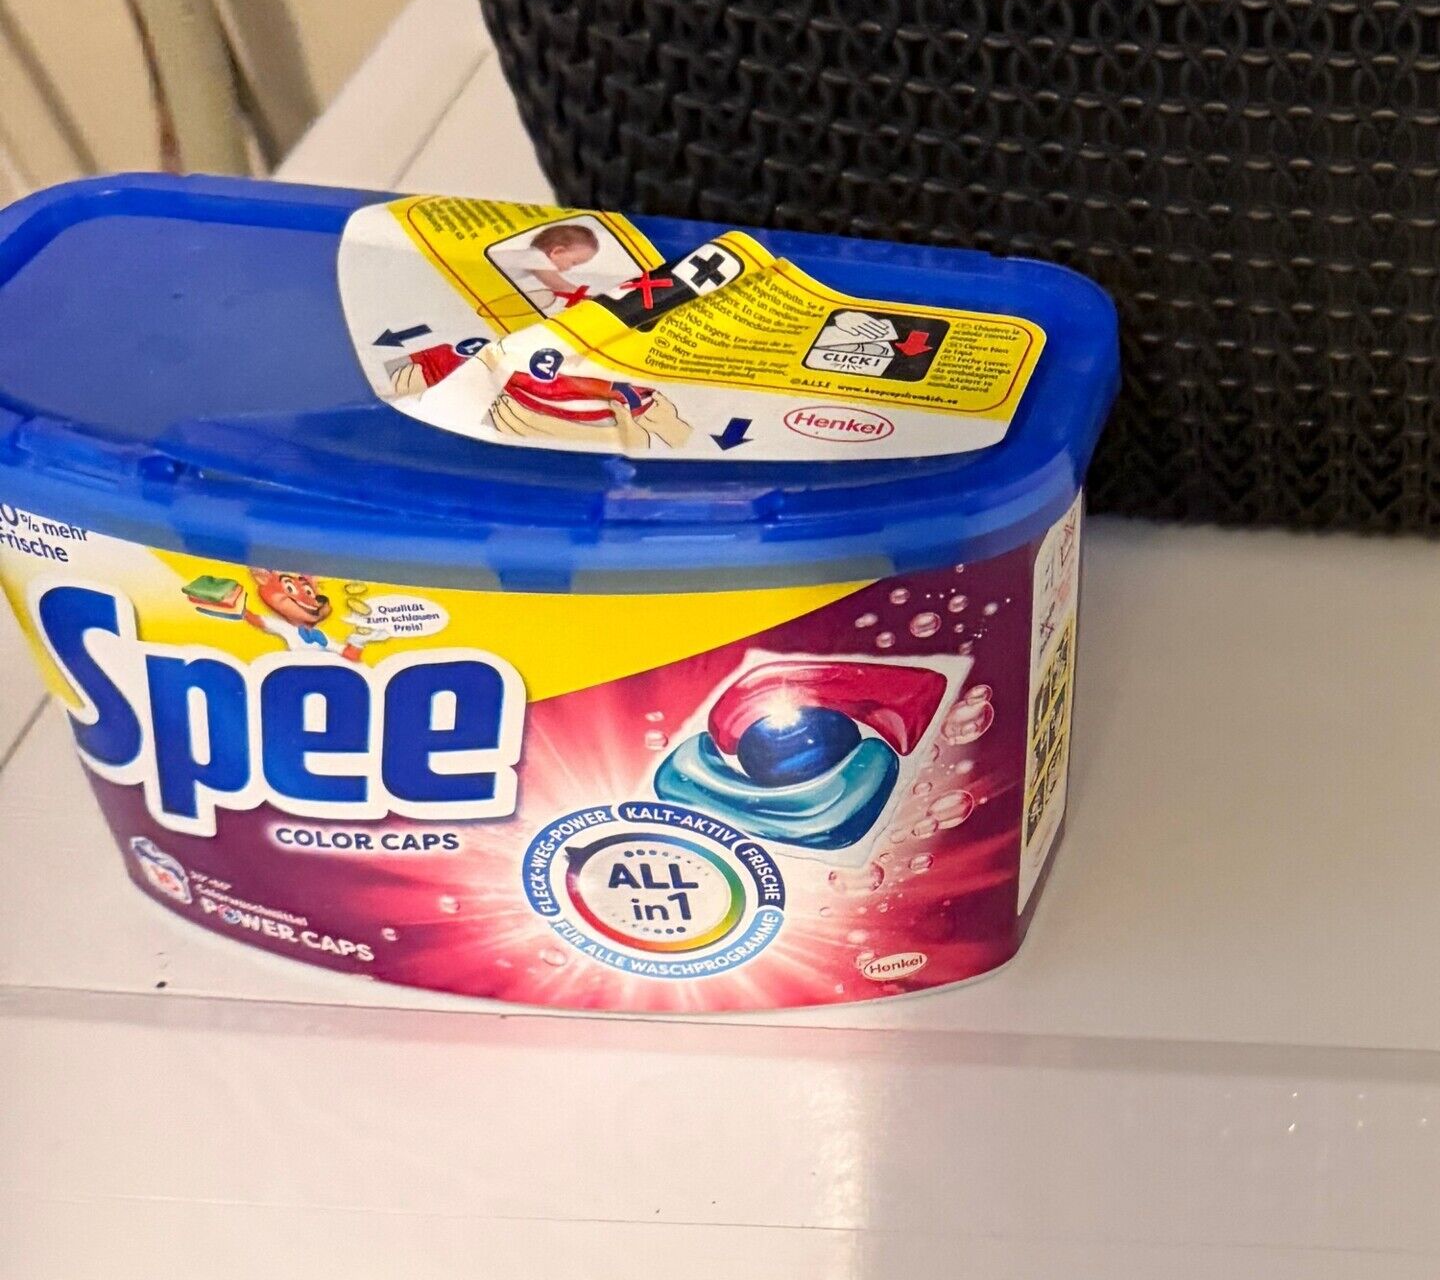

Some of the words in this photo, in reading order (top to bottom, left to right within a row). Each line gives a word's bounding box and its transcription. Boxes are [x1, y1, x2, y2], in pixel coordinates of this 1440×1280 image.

[536, 355, 555, 378] 2
[794, 412, 885, 436] Henkel
[42, 522, 88, 541] mehr
[38, 585, 506, 819] Spee
[626, 807, 737, 843] KALT-AKTIV
[275, 827, 374, 851] COLOR
[381, 832, 459, 852] CAPS
[608, 863, 699, 889] ALL
[741, 847, 781, 901] FRISCHE
[301, 931, 375, 962] CAPS
[554, 918, 585, 945] FÜR
[584, 943, 625, 967] ALLE
